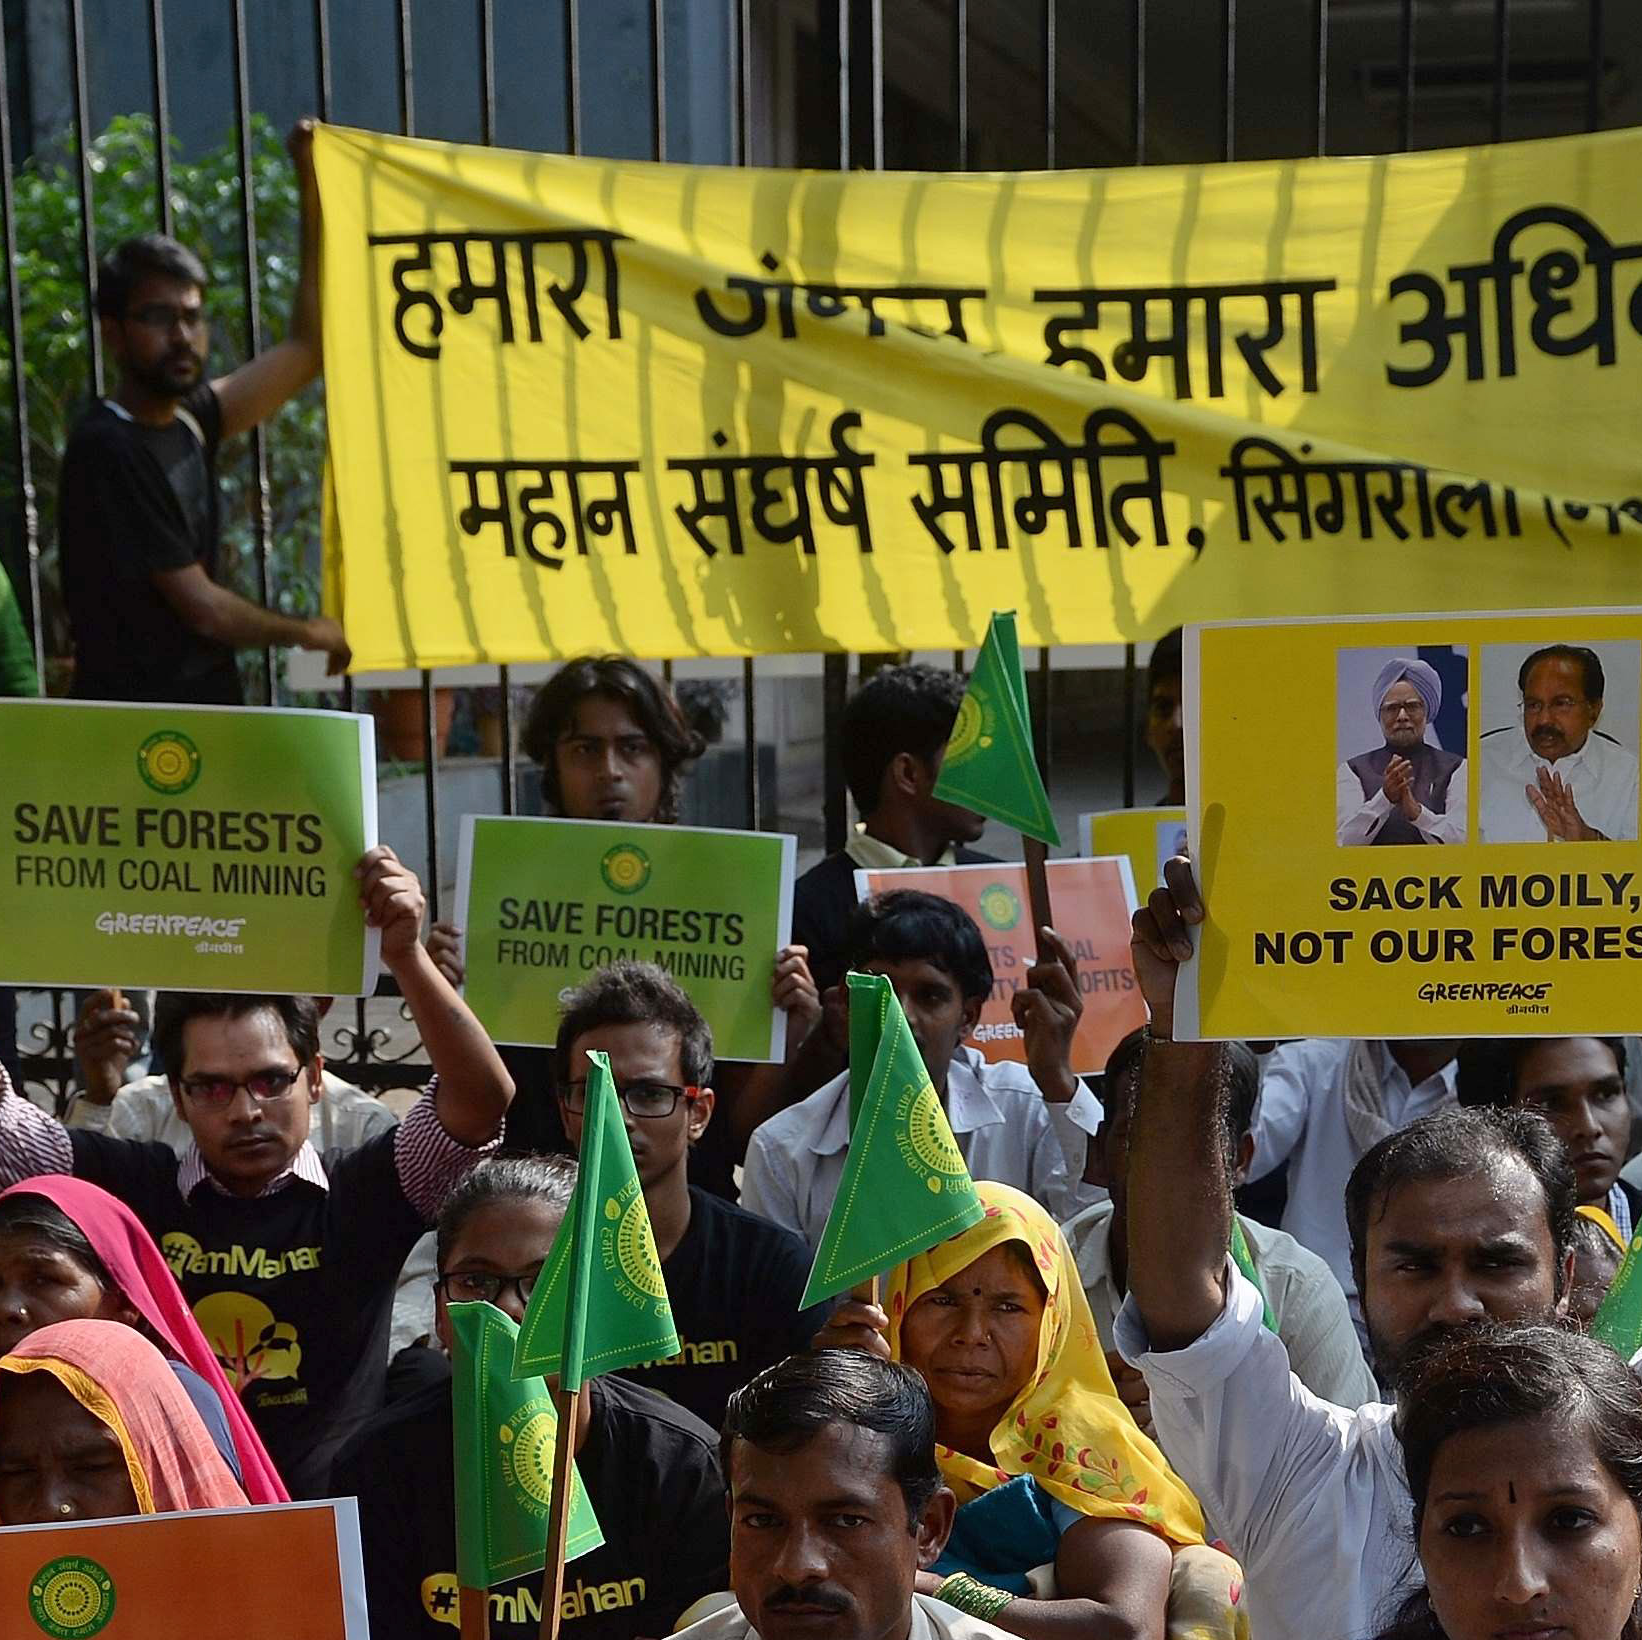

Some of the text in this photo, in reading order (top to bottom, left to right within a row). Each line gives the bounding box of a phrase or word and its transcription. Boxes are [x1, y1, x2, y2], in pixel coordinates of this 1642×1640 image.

[368, 229, 635, 360] हमारा
[1033, 278, 1337, 400] हमारा
[449, 459, 639, 571] महान
[667, 411, 875, 557] संघर्ष
[908, 407, 1205, 566] समिति,
[13, 803, 324, 856] SAVE FORESTS
[14, 855, 327, 897] FROM COAL MINING
[1328, 871, 1642, 917] SACK MOILY,
[95, 911, 247, 938] GREENPEACE
[499, 897, 745, 946] SAVE FORESTS
[497, 938, 569, 968] FROM
[655, 950, 745, 981] MINING
[1253, 930, 1354, 966] NOT
[1369, 928, 1475, 964] OUR
[1418, 981, 1553, 1004] GREENPEACE
[973, 1022, 1025, 1043] GREEN
